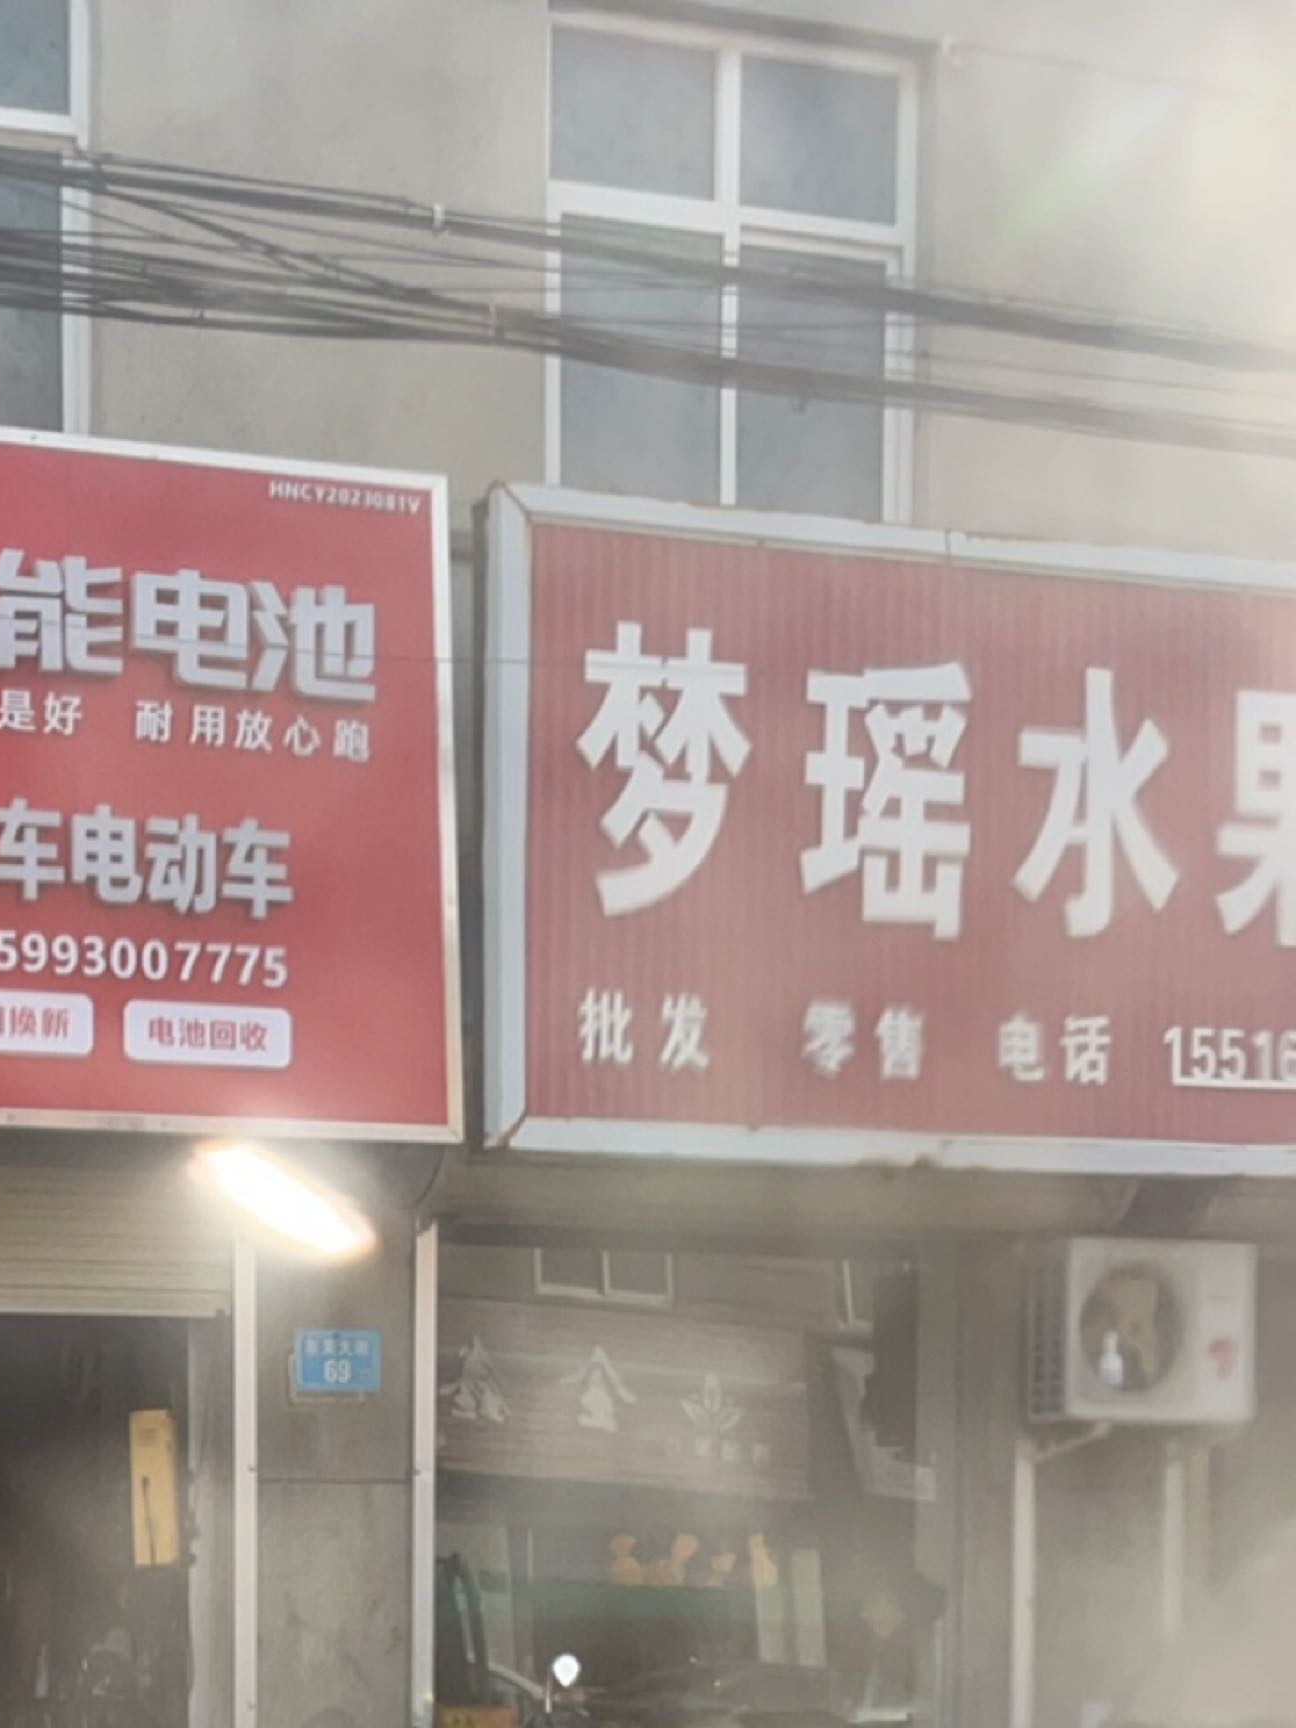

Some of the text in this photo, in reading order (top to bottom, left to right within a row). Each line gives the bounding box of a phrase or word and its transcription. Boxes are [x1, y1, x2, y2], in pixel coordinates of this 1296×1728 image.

[135, 699, 371, 763] 耐用放心跑
[148, 1015, 268, 1052] 电池回收
[579, 988, 710, 1071] 批发
[802, 1000, 925, 1080] 零售
[998, 1013, 1111, 1086] 电话
